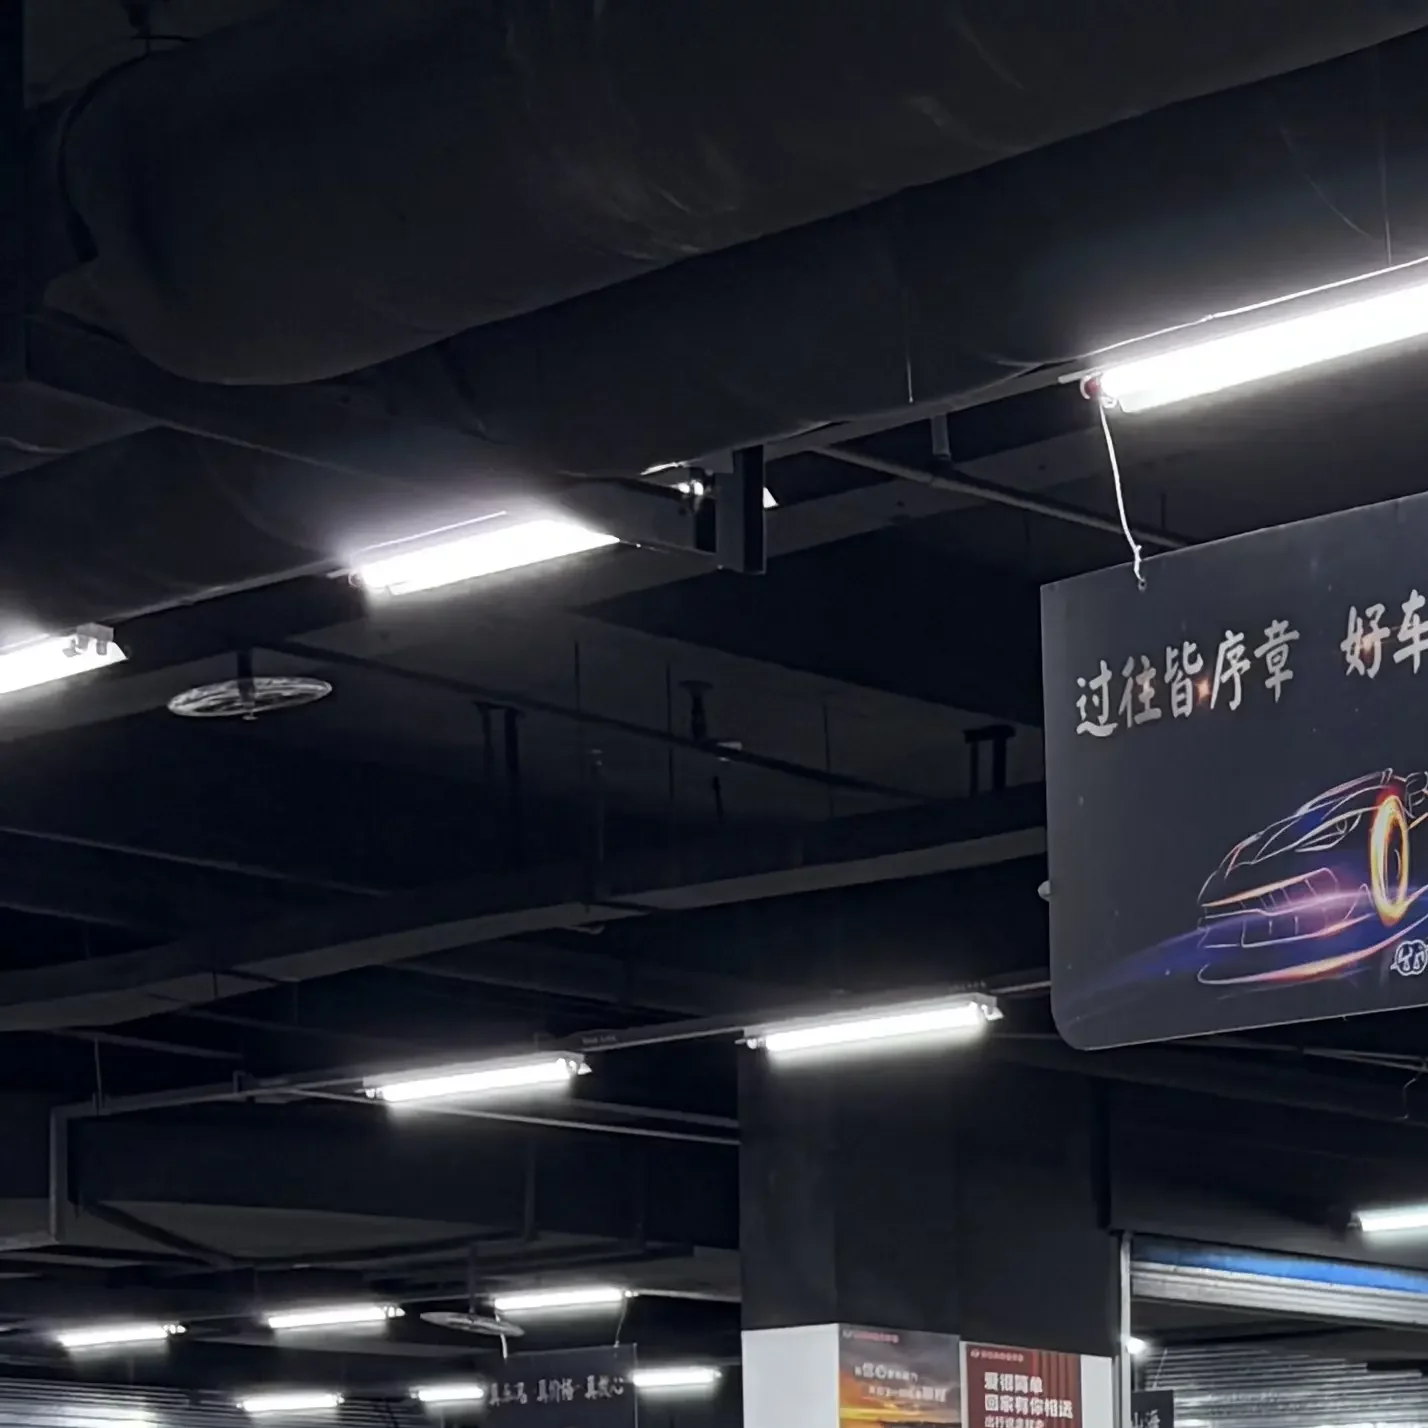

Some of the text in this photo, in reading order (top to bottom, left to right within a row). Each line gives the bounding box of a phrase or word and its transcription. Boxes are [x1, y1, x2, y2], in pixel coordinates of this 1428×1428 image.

[1076, 620, 1299, 736] 过往皆序章
